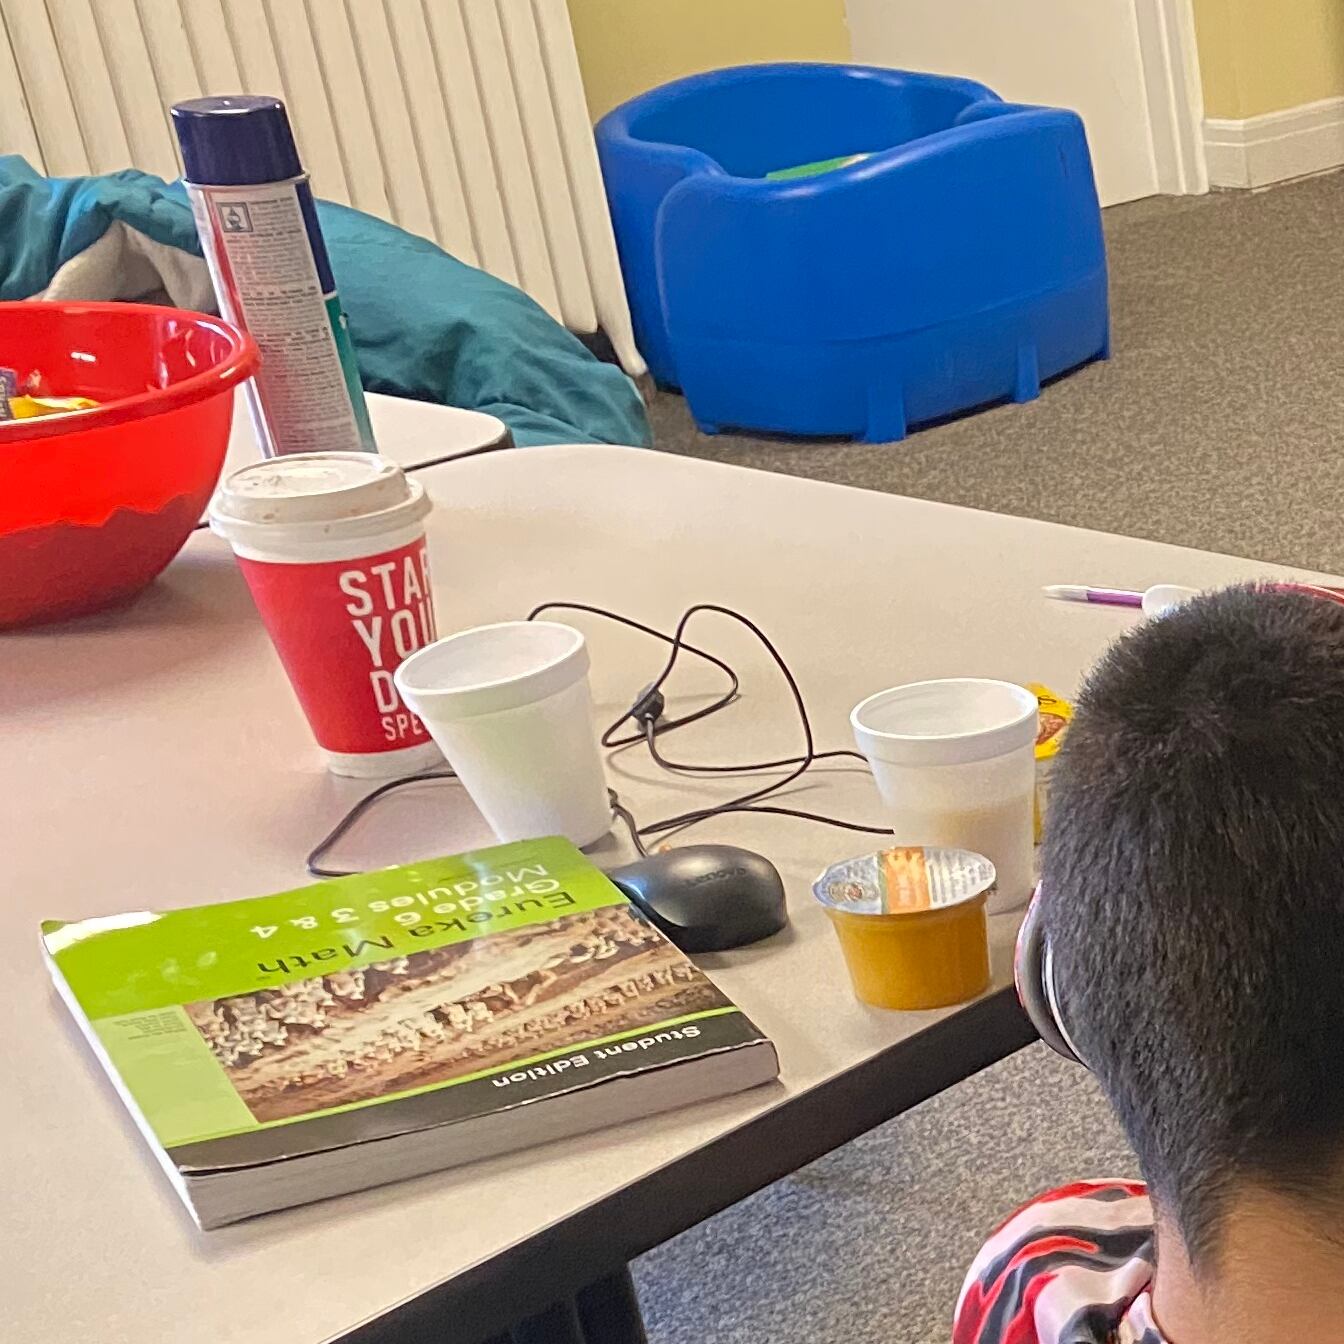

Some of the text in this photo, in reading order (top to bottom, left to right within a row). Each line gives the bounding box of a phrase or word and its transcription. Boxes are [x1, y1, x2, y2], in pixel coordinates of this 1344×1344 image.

[248, 863, 550, 939] Modules 3 & 4
[393, 878, 560, 926] Grade 6
[407, 891, 577, 938] Eureka
[491, 1025, 701, 1088] Student Edition
